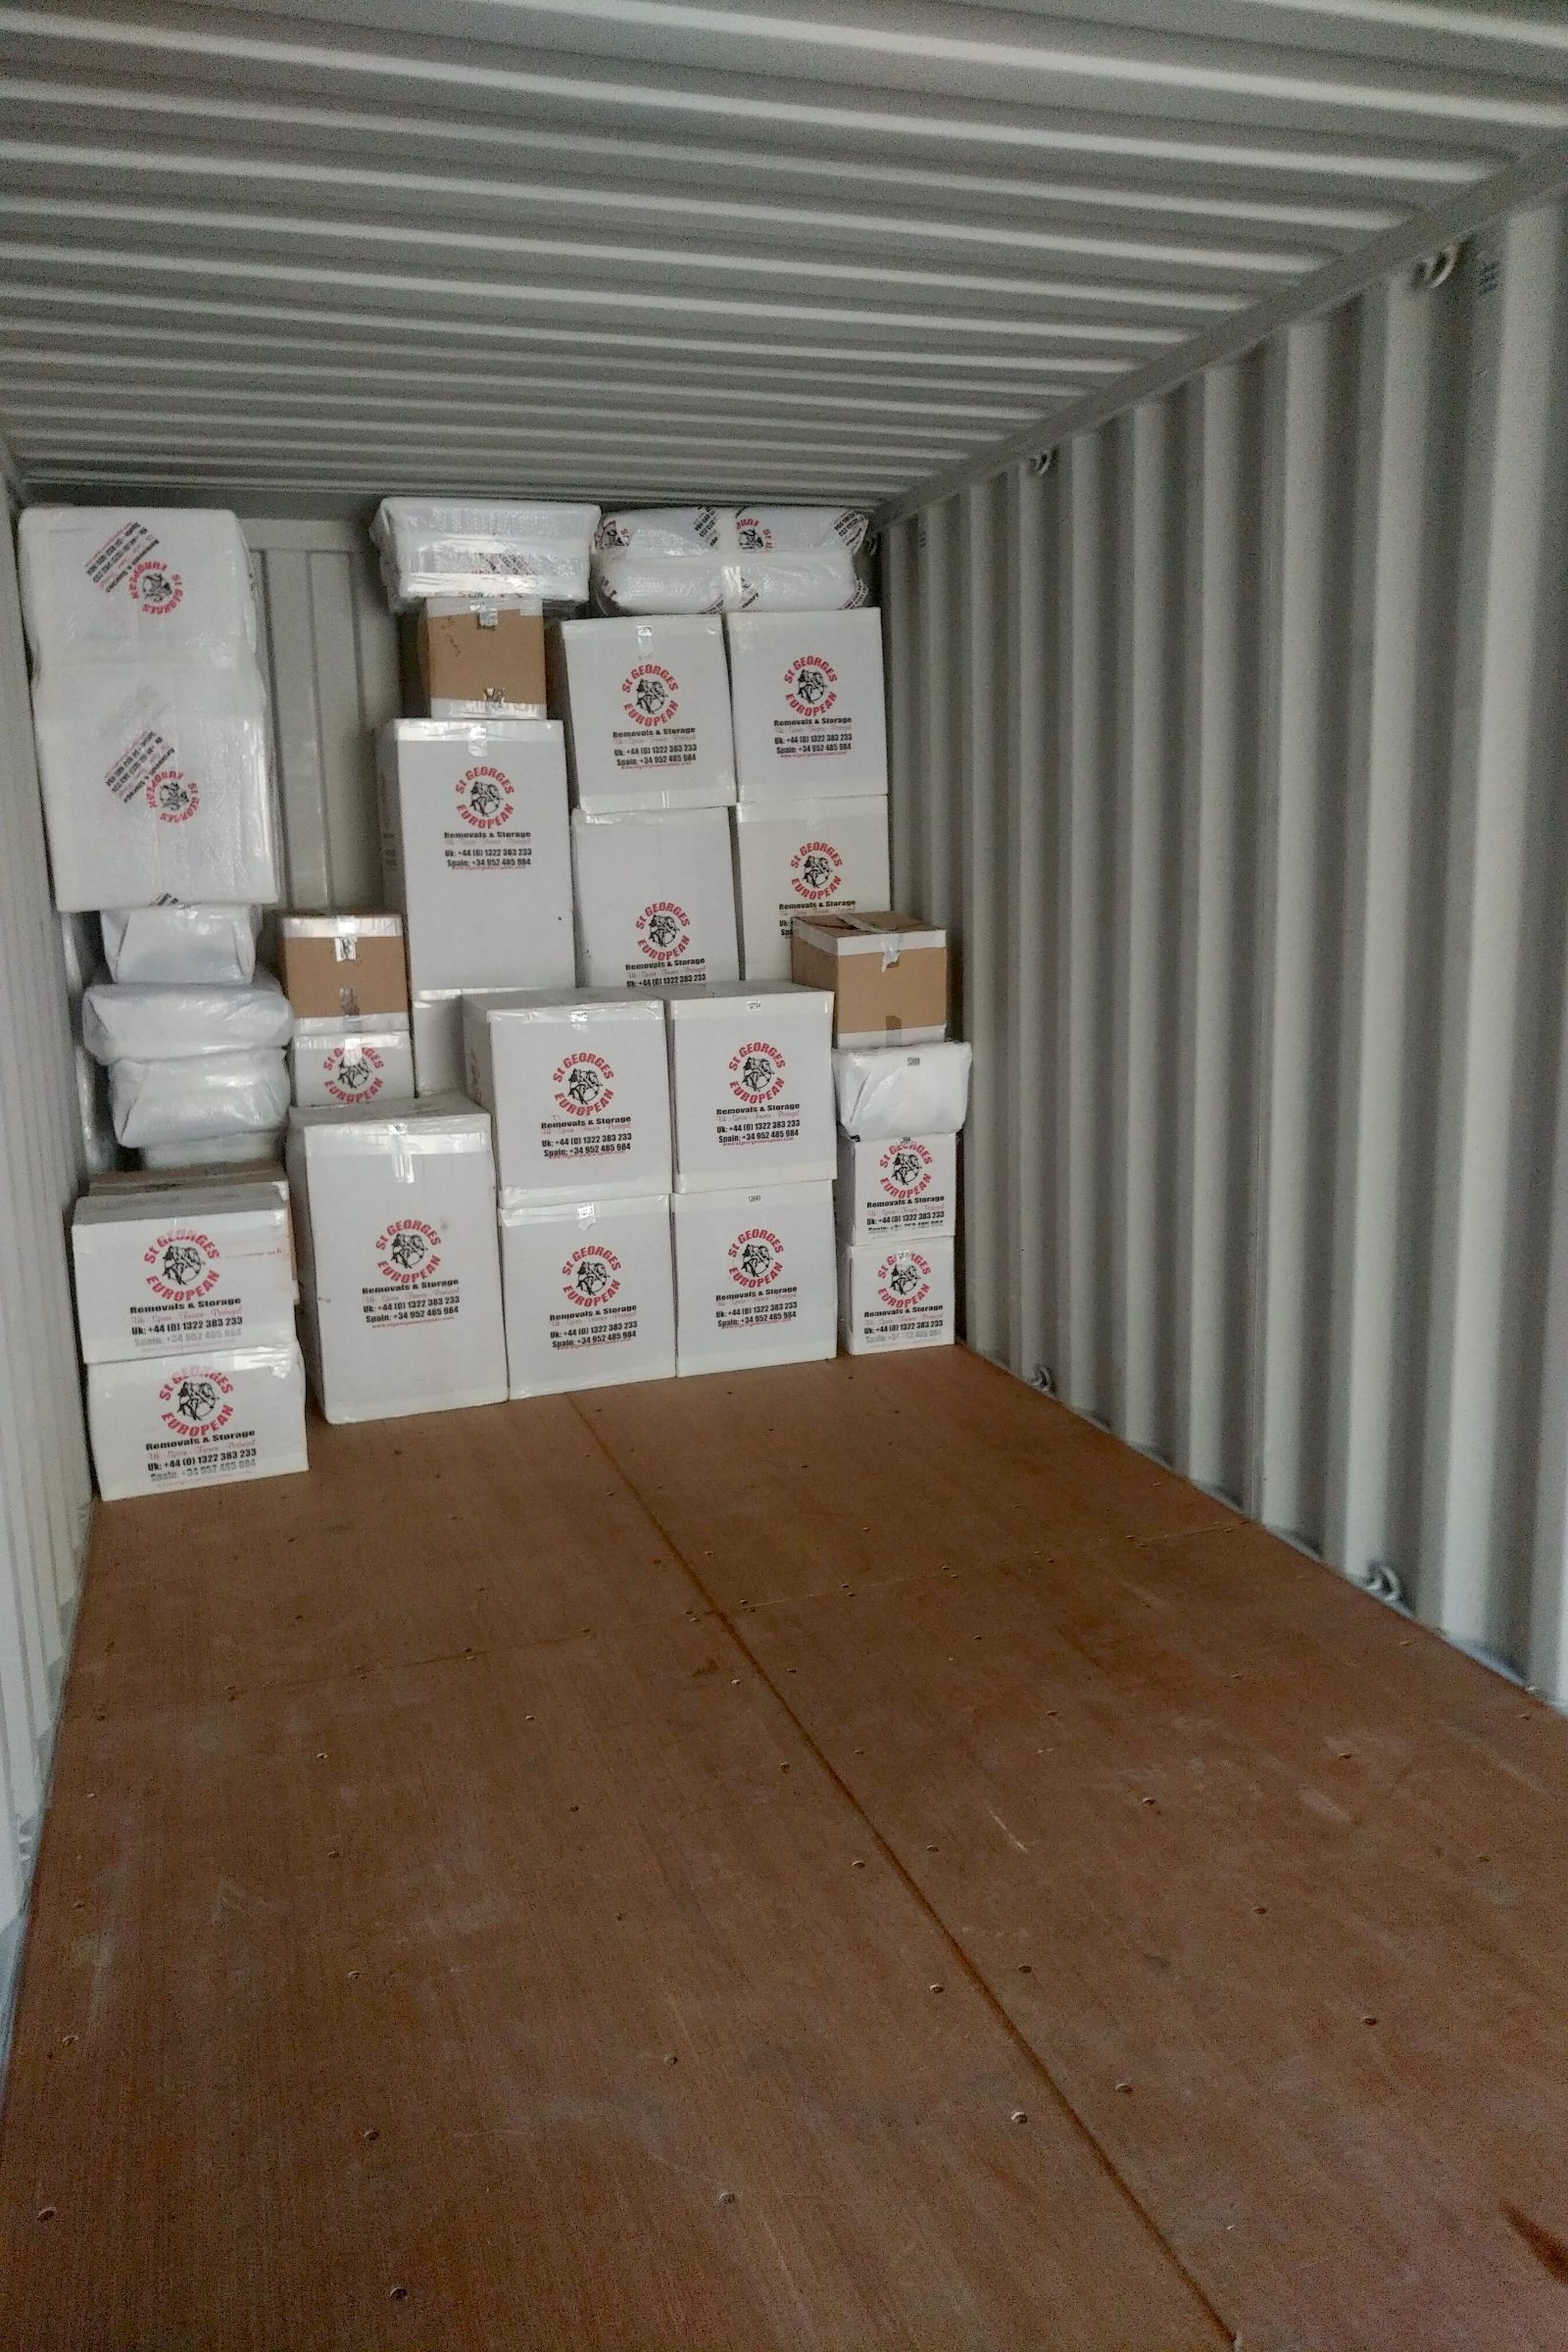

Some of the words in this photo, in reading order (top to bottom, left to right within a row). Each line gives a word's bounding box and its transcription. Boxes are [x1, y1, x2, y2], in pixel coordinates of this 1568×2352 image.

[631, 664, 678, 691] GEORGES
[793, 656, 837, 682] GEORGES
[623, 700, 679, 726] EUROPEAN
[785, 691, 837, 716] EUROPEAN
[612, 729, 653, 738] Removals
[457, 804, 514, 829] EUROPEAN
[790, 856, 801, 868] St
[800, 842, 843, 866] GEORGES
[791, 875, 842, 900] EUROPEAN
[636, 915, 647, 929] St
[645, 902, 690, 926] GEORGES
[637, 935, 690, 960] EUROPEAN
[625, 961, 665, 970] Removals
[554, 1067, 565, 1082] St
[564, 1053, 614, 1079] GEORGES
[729, 1056, 741, 1071] St
[739, 1042, 786, 1068] GEORGES
[324, 1077, 383, 1103] EUROPEAN
[555, 1089, 613, 1116] EUROPEAN
[729, 1077, 785, 1103] EUROPEAN
[716, 1106, 758, 1115] Removals
[541, 1119, 586, 1129] Removals
[880, 1173, 932, 1199] EUROPEAN
[867, 1200, 906, 1208] Removals
[387, 1219, 441, 1246] GEORGES
[728, 1243, 740, 1257] St
[738, 1229, 784, 1253] GEORGES
[144, 1246, 160, 1264] St
[563, 1261, 574, 1275] St
[572, 1246, 621, 1270] GEORGES
[377, 1254, 441, 1283] EUROPEAN
[729, 1262, 783, 1288] EUROPEAN
[146, 1270, 220, 1301] EUROPEAN
[363, 1284, 410, 1294] Removals
[421, 1279, 459, 1289] Storage
[563, 1280, 620, 1306] EUROPEAN
[715, 1292, 756, 1301] Removals
[878, 1283, 930, 1308] EUROPEAN
[130, 1303, 184, 1313] Removals
[198, 1298, 241, 1307] Storage
[550, 1310, 593, 1321] Removals
[160, 1384, 173, 1400] St
[162, 1404, 233, 1437] EUROPEAN
[146, 1439, 200, 1450] Removals
[213, 1431, 255, 1442] Storage
